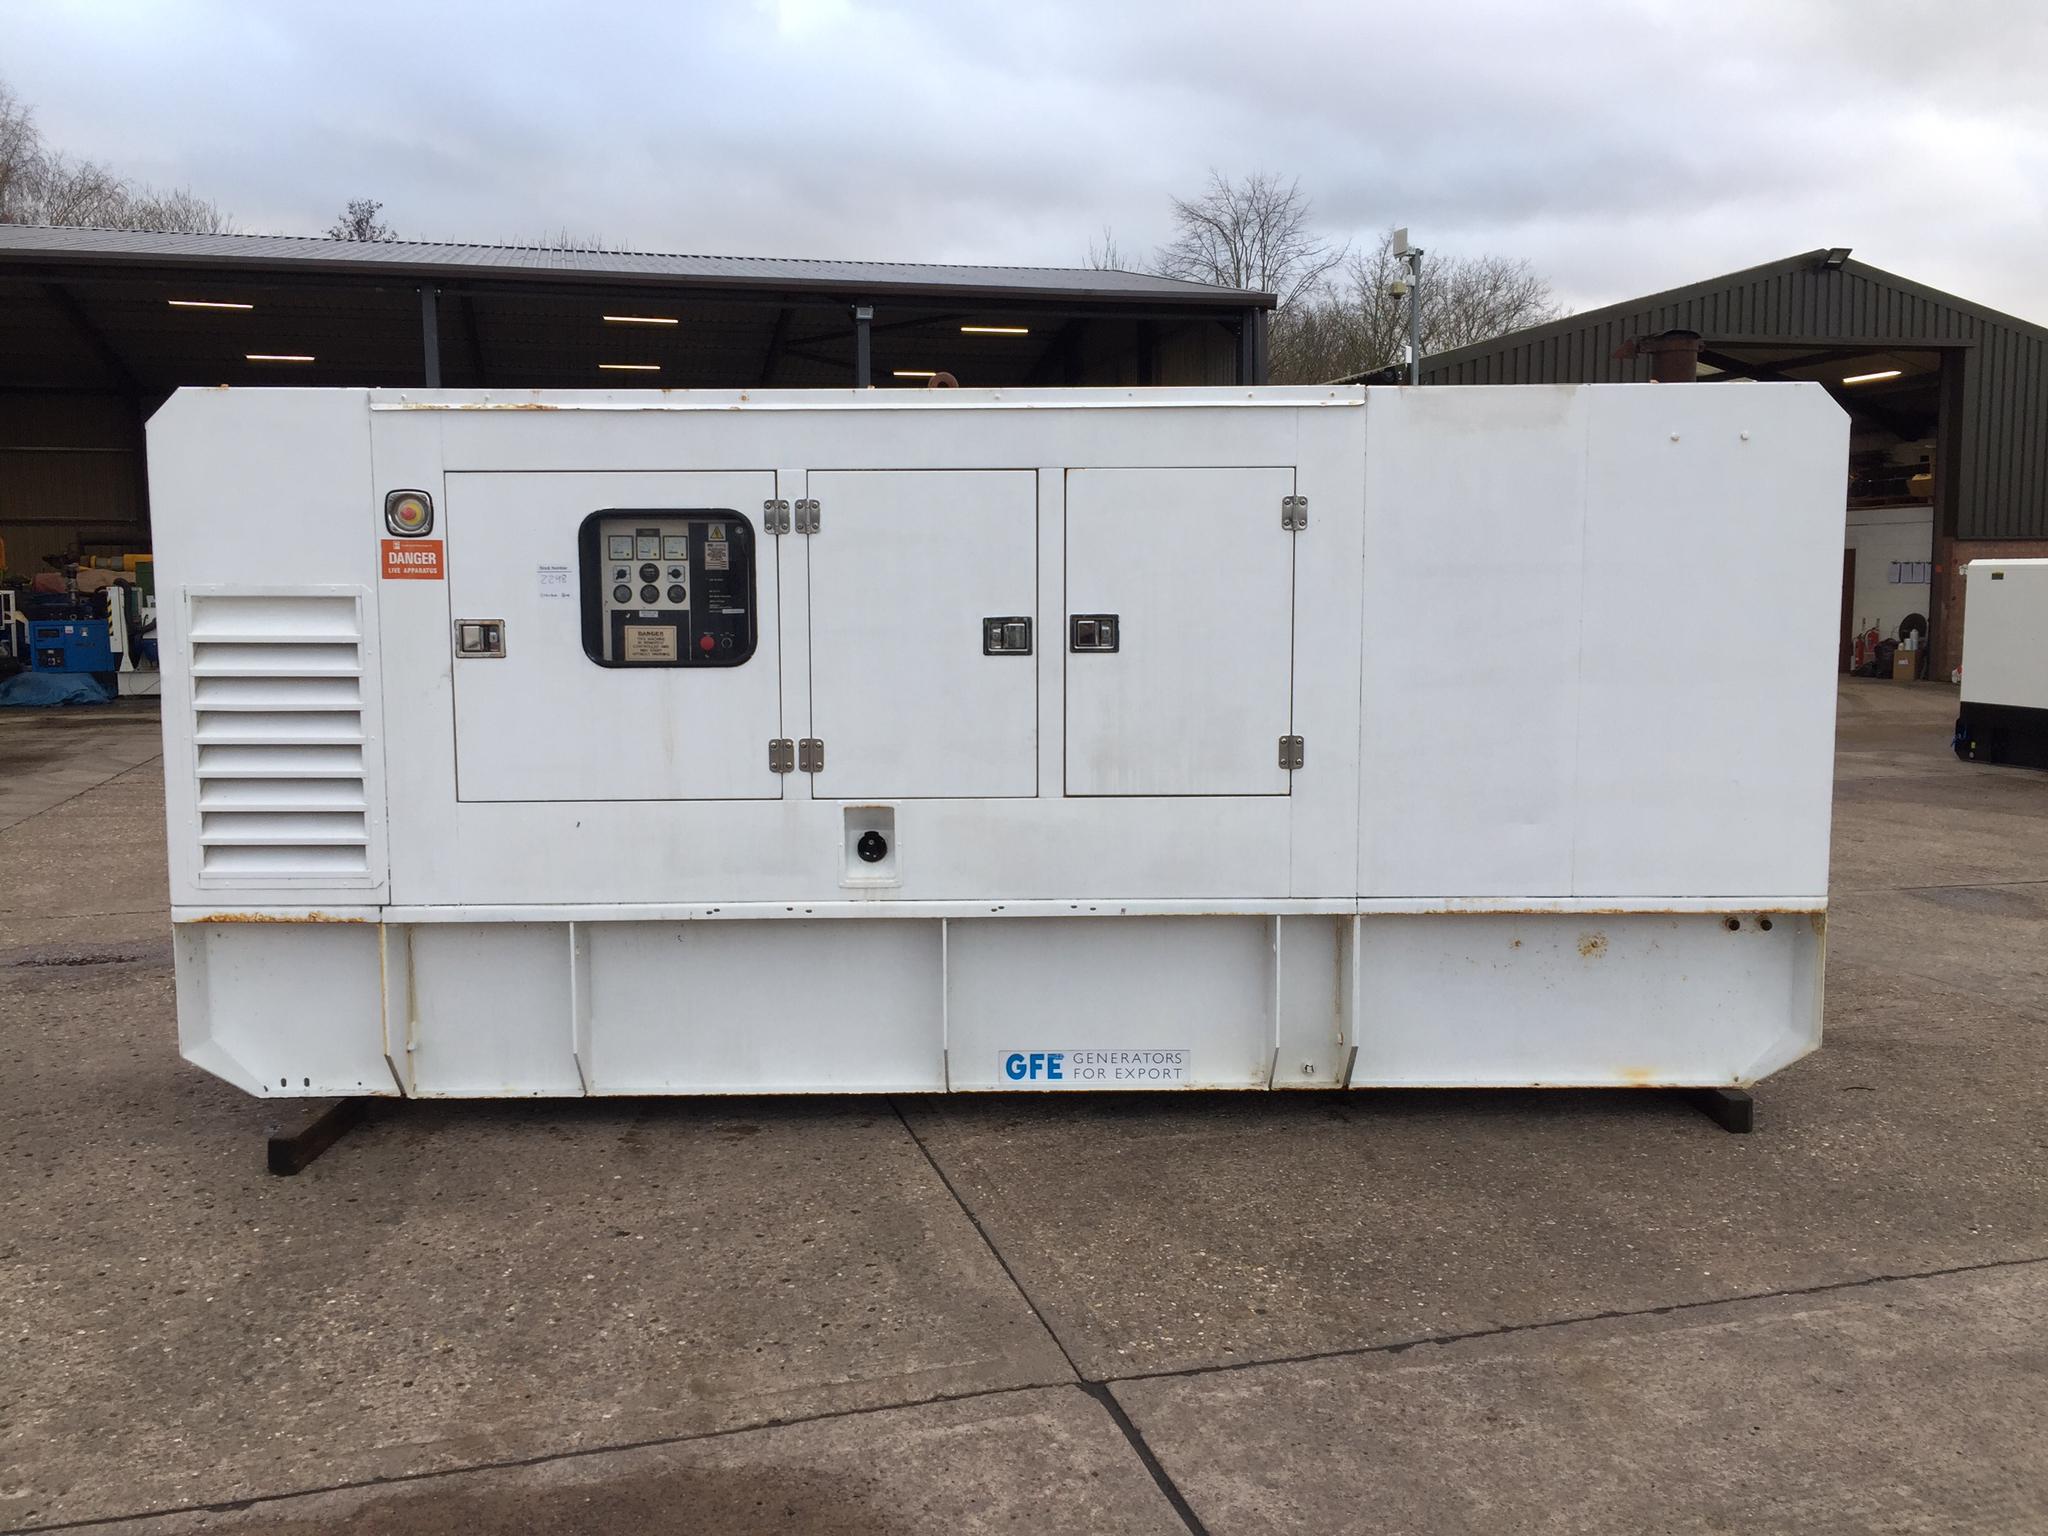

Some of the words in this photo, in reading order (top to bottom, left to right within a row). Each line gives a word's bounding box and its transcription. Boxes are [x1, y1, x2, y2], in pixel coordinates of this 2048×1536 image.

[388, 551, 437, 565] DANGER
[1073, 1052, 1182, 1065] GENERATORS
[1006, 1053, 1064, 1080] GFE
[1073, 1067, 1106, 1080] FOR
[1115, 1067, 1182, 1080] EXPORT
